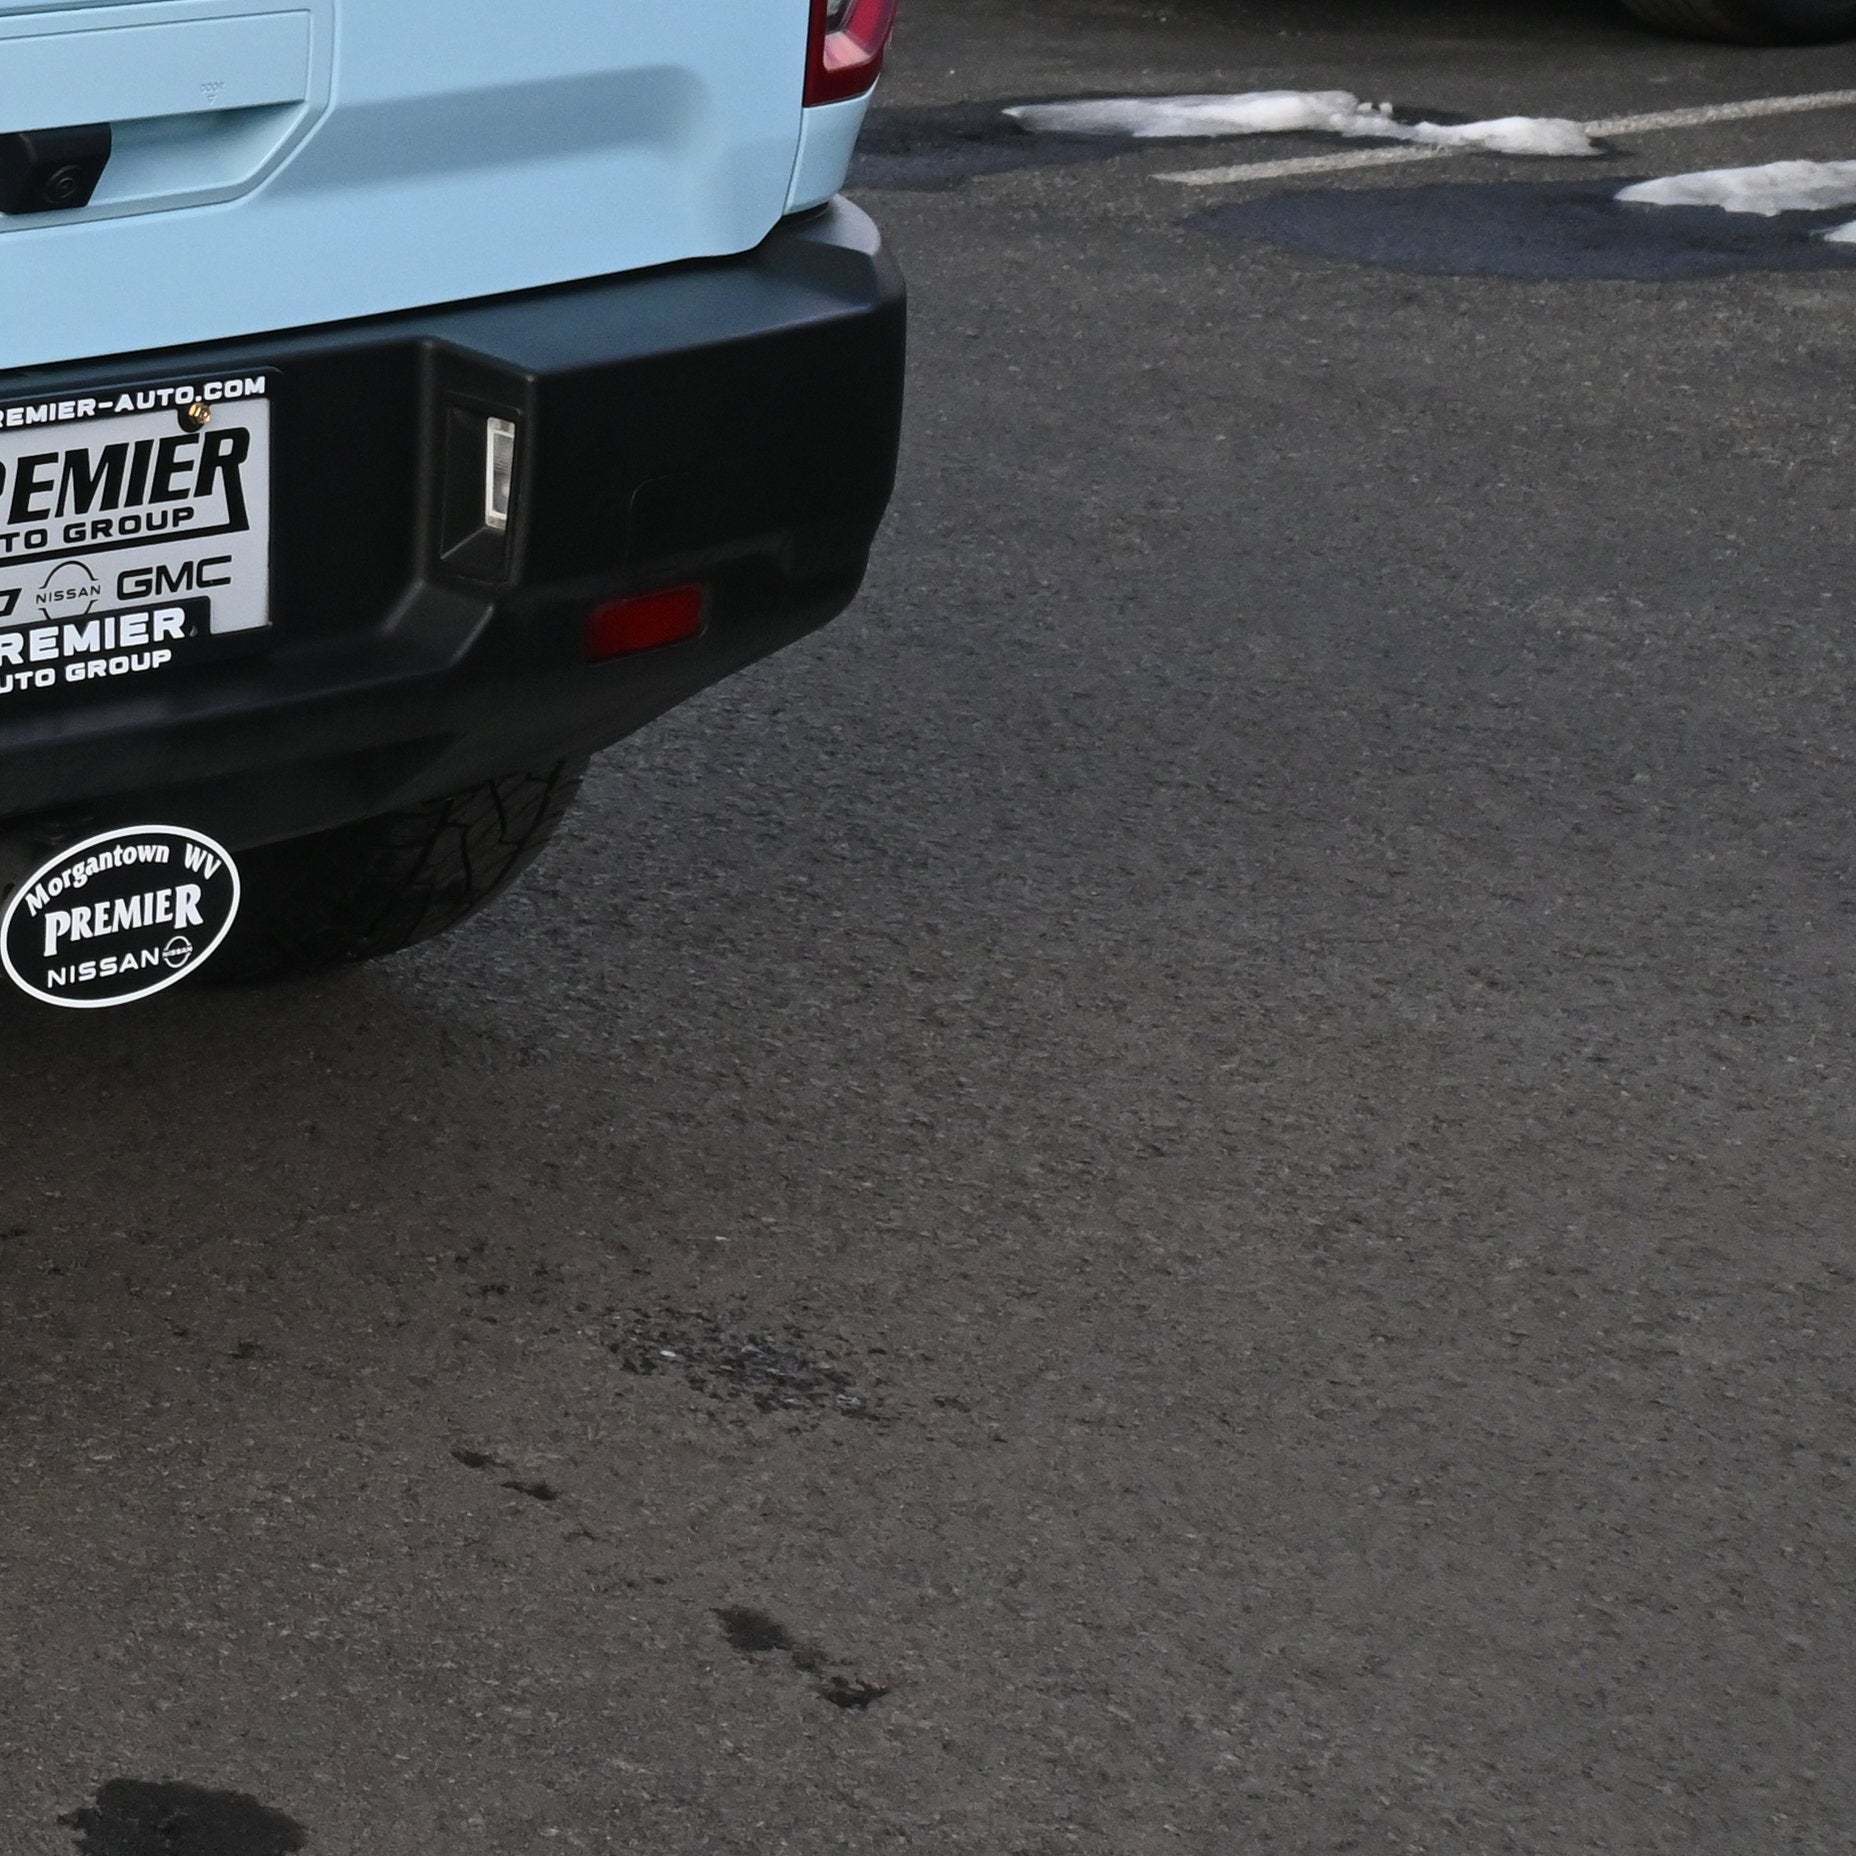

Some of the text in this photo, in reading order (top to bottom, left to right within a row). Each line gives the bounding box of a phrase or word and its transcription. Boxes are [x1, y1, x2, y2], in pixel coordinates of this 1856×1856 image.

[63, 506, 195, 543] GROUP
[36, 555, 232, 605] NISSAN GMC
[65, 649, 172, 682] GROUP
[24, 843, 222, 917] Morgantown WV
[43, 883, 204, 958] PREMIER
[47, 947, 160, 989] NISSAN
